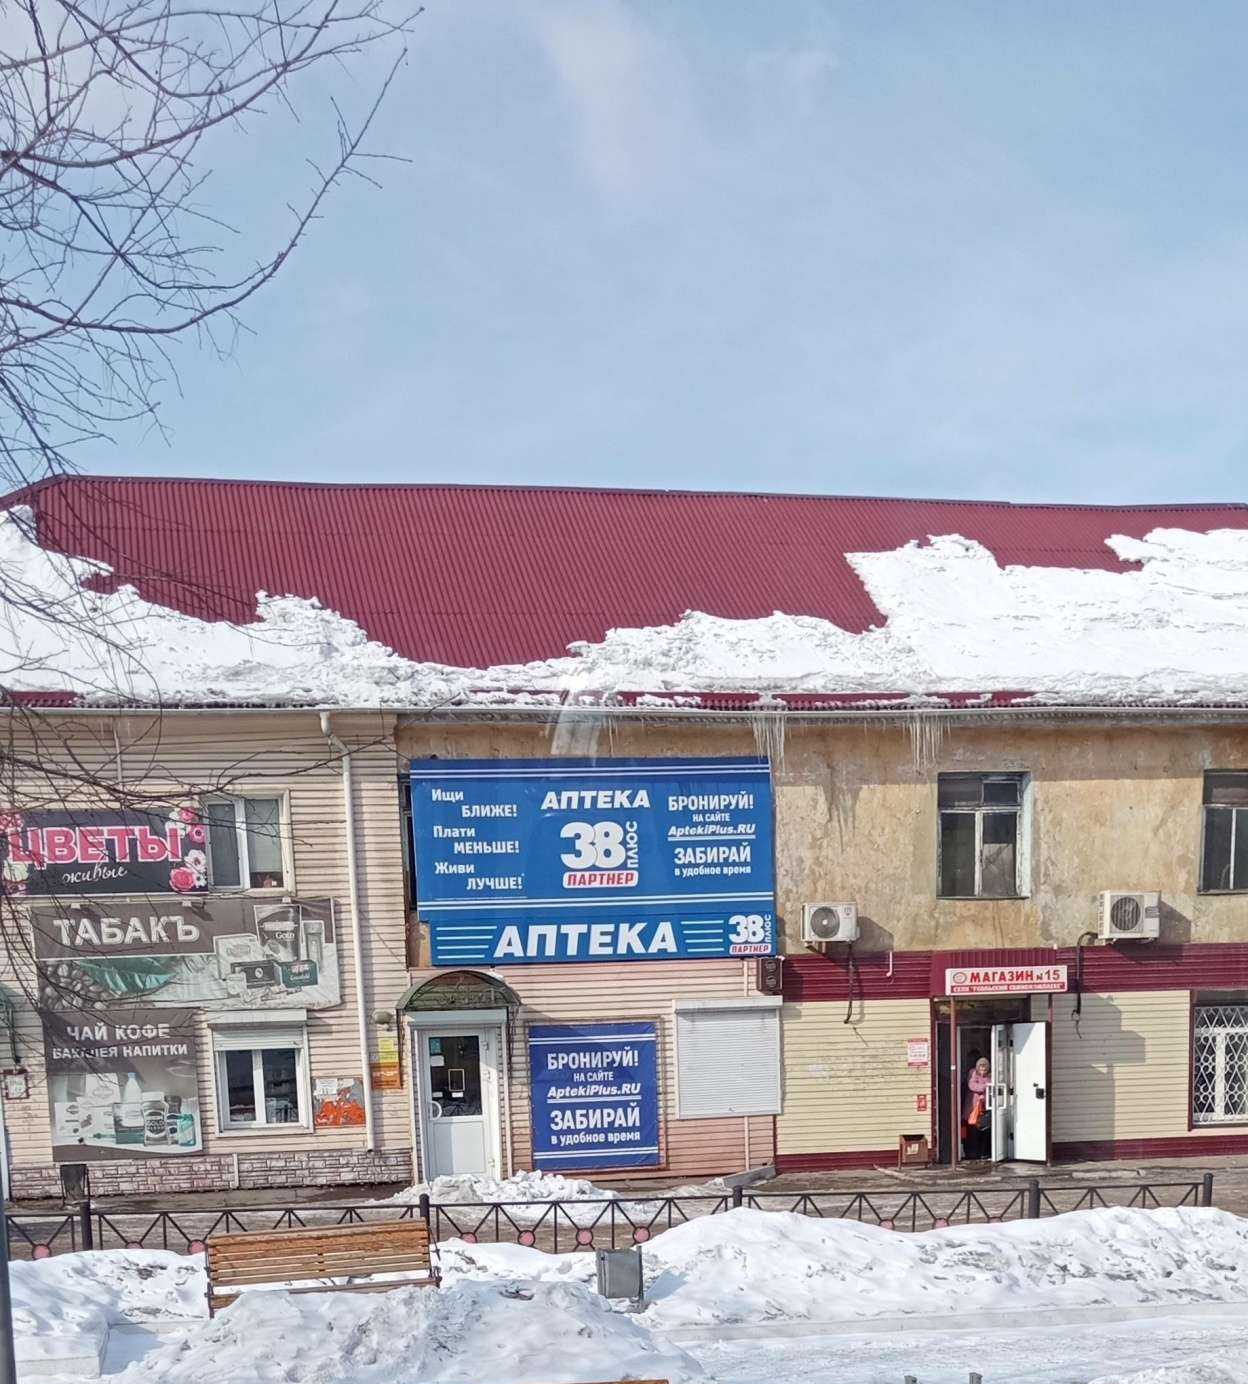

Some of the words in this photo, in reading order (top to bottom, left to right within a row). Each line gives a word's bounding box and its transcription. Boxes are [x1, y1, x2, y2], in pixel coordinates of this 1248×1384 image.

[431, 788, 464, 803] Ищи
[540, 789, 650, 810] АПТЕКА
[668, 790, 754, 811] БРОНИРУЙ!
[461, 804, 518, 818] БЛИЖЕ!
[692, 813, 704, 822] НА
[705, 811, 731, 822] САЙТЕ
[433, 825, 476, 838] Плати
[667, 823, 756, 837] AptekiPlus.RU
[9, 825, 183, 871] ЦВЕТЫ
[454, 840, 520, 854] МЕНЬШЕ!
[560, 821, 626, 869] 38
[625, 821, 639, 868] ПЛЮС
[674, 841, 751, 864] ЗАБИРАЙ
[62, 863, 128, 884] живые
[434, 861, 475, 874] Живи
[674, 868, 680, 876] в
[682, 865, 721, 878] удобное
[722, 865, 752, 877] время
[466, 876, 523, 890] ЛУЧШЕ!
[567, 872, 635, 886] ПАРТНЕР
[53, 915, 200, 947] ТАБАКЪ
[728, 914, 765, 943] 38
[764, 914, 772, 943] ПЛЮС
[493, 921, 678, 958] АПТЕКА
[732, 945, 769, 953] ПАРТНЕР
[970, 969, 1034, 983] МАГАЗИН
[67, 1022, 108, 1041] ЧАЙ
[115, 1023, 171, 1041] КОФЕ
[123, 1044, 188, 1057] НАПИТКИ
[547, 1046, 639, 1070] БРОНИРУЙ!
[573, 1072, 586, 1082] НА
[587, 1070, 614, 1081] САЙТЕ
[547, 1083, 641, 1099] AptekiPlus.RU
[550, 1102, 640, 1131] ЗАБИРАЙ
[551, 1135, 557, 1145] в
[560, 1131, 606, 1146] удобное
[608, 1131, 641, 1144] время
